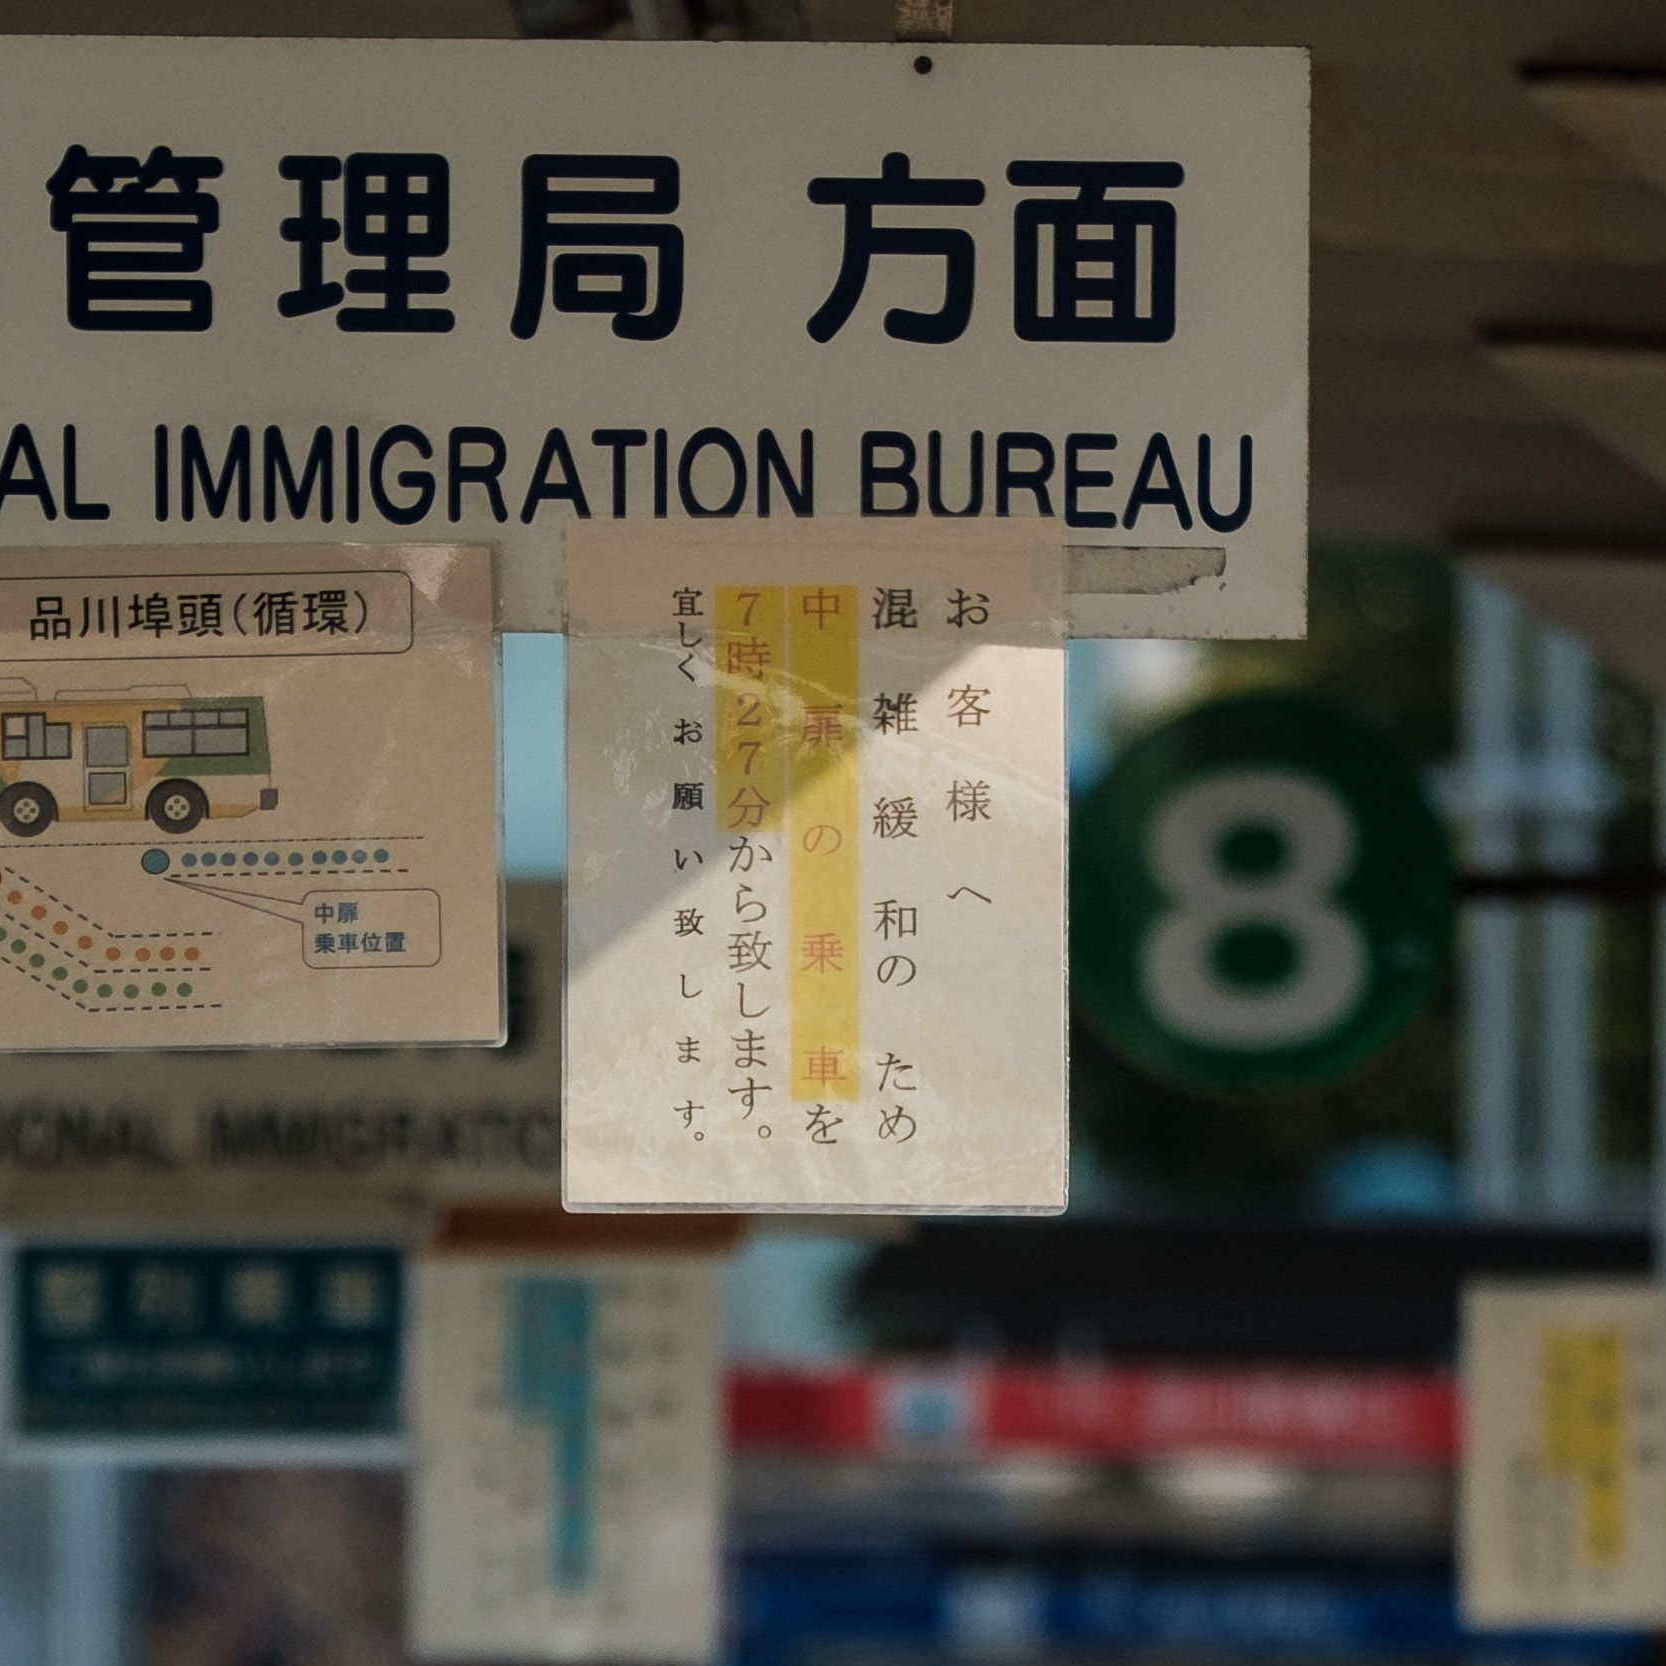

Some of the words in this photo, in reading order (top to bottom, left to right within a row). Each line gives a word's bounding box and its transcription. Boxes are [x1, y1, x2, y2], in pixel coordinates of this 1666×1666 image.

[806, 152, 1185, 345] 方面
[154, 423, 814, 526] IMMIGRATION
[861, 429, 1253, 533] BUREAU
[672, 586, 705, 1142] 宜しくお願い致します。
[799, 587, 846, 1145] 中扉の乗車を
[871, 586, 918, 1144] 混雑緩和のため
[946, 587, 993, 905] お客様へ
[312, 931, 407, 955] 乗車位置
[313, 902, 360, 925] 中扉
[1136, 763, 1371, 1054] 8
[209, 1100, 563, 1172] IMMIGRATIO
